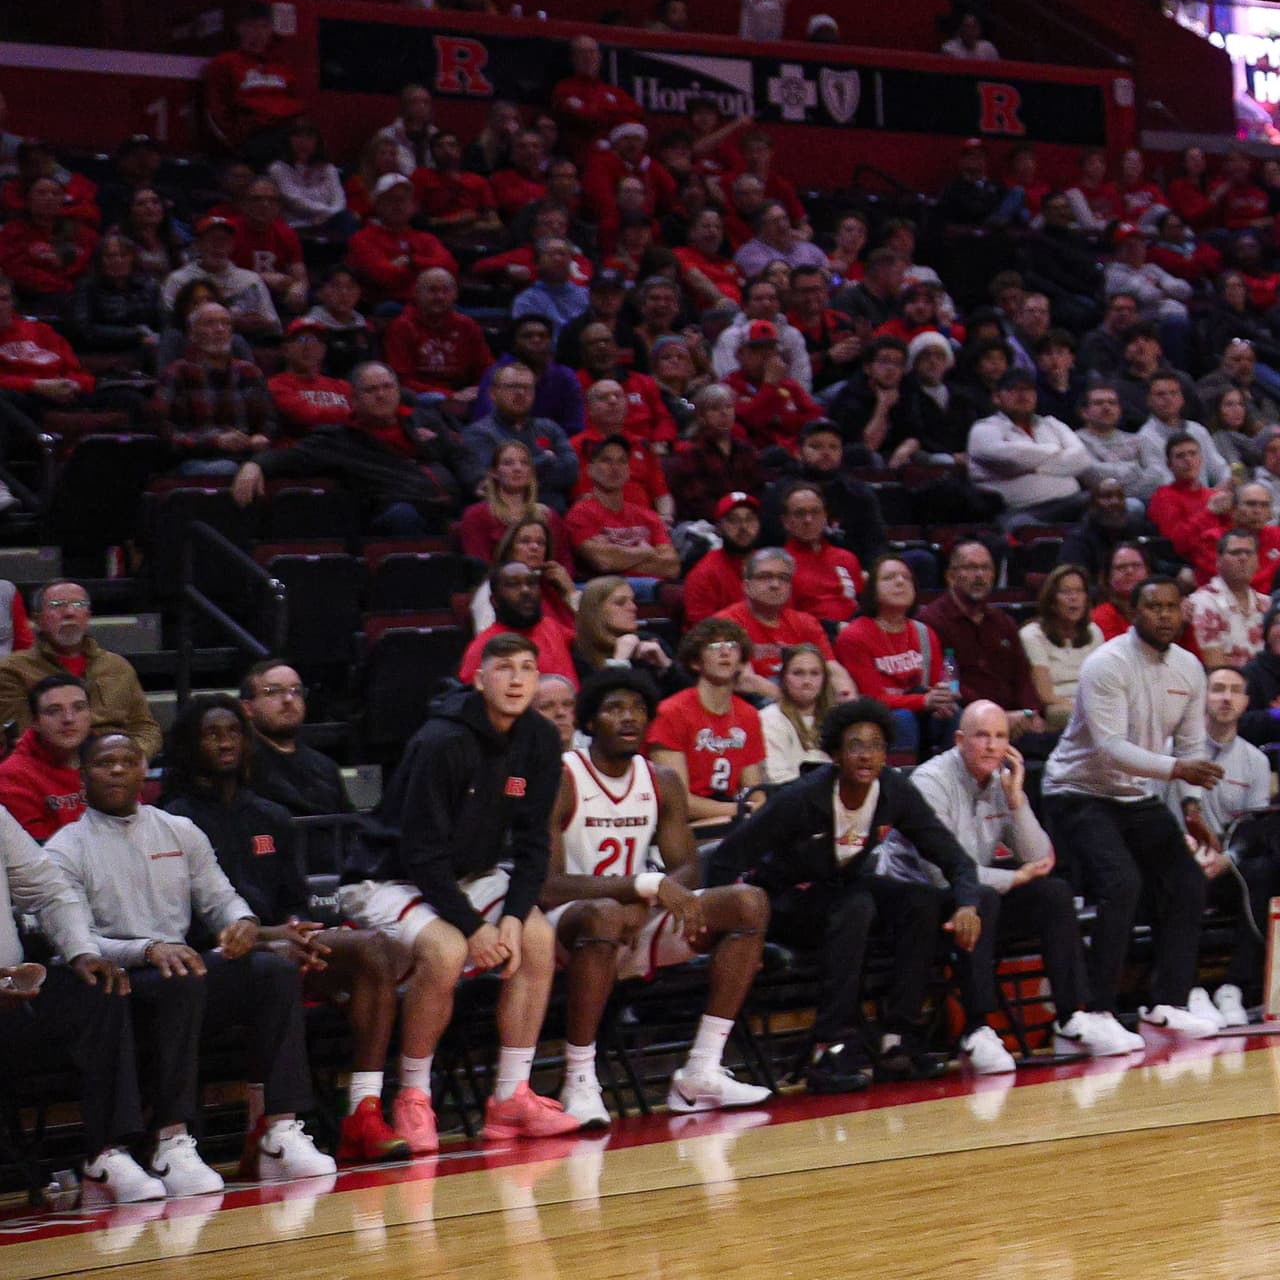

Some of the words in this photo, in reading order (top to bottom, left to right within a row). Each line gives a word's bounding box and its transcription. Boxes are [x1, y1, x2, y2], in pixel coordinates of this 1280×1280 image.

[432, 35, 493, 97] R
[977, 81, 1027, 137] R
[503, 775, 527, 798] R
[253, 834, 277, 856] R
[593, 836, 636, 876] 21
